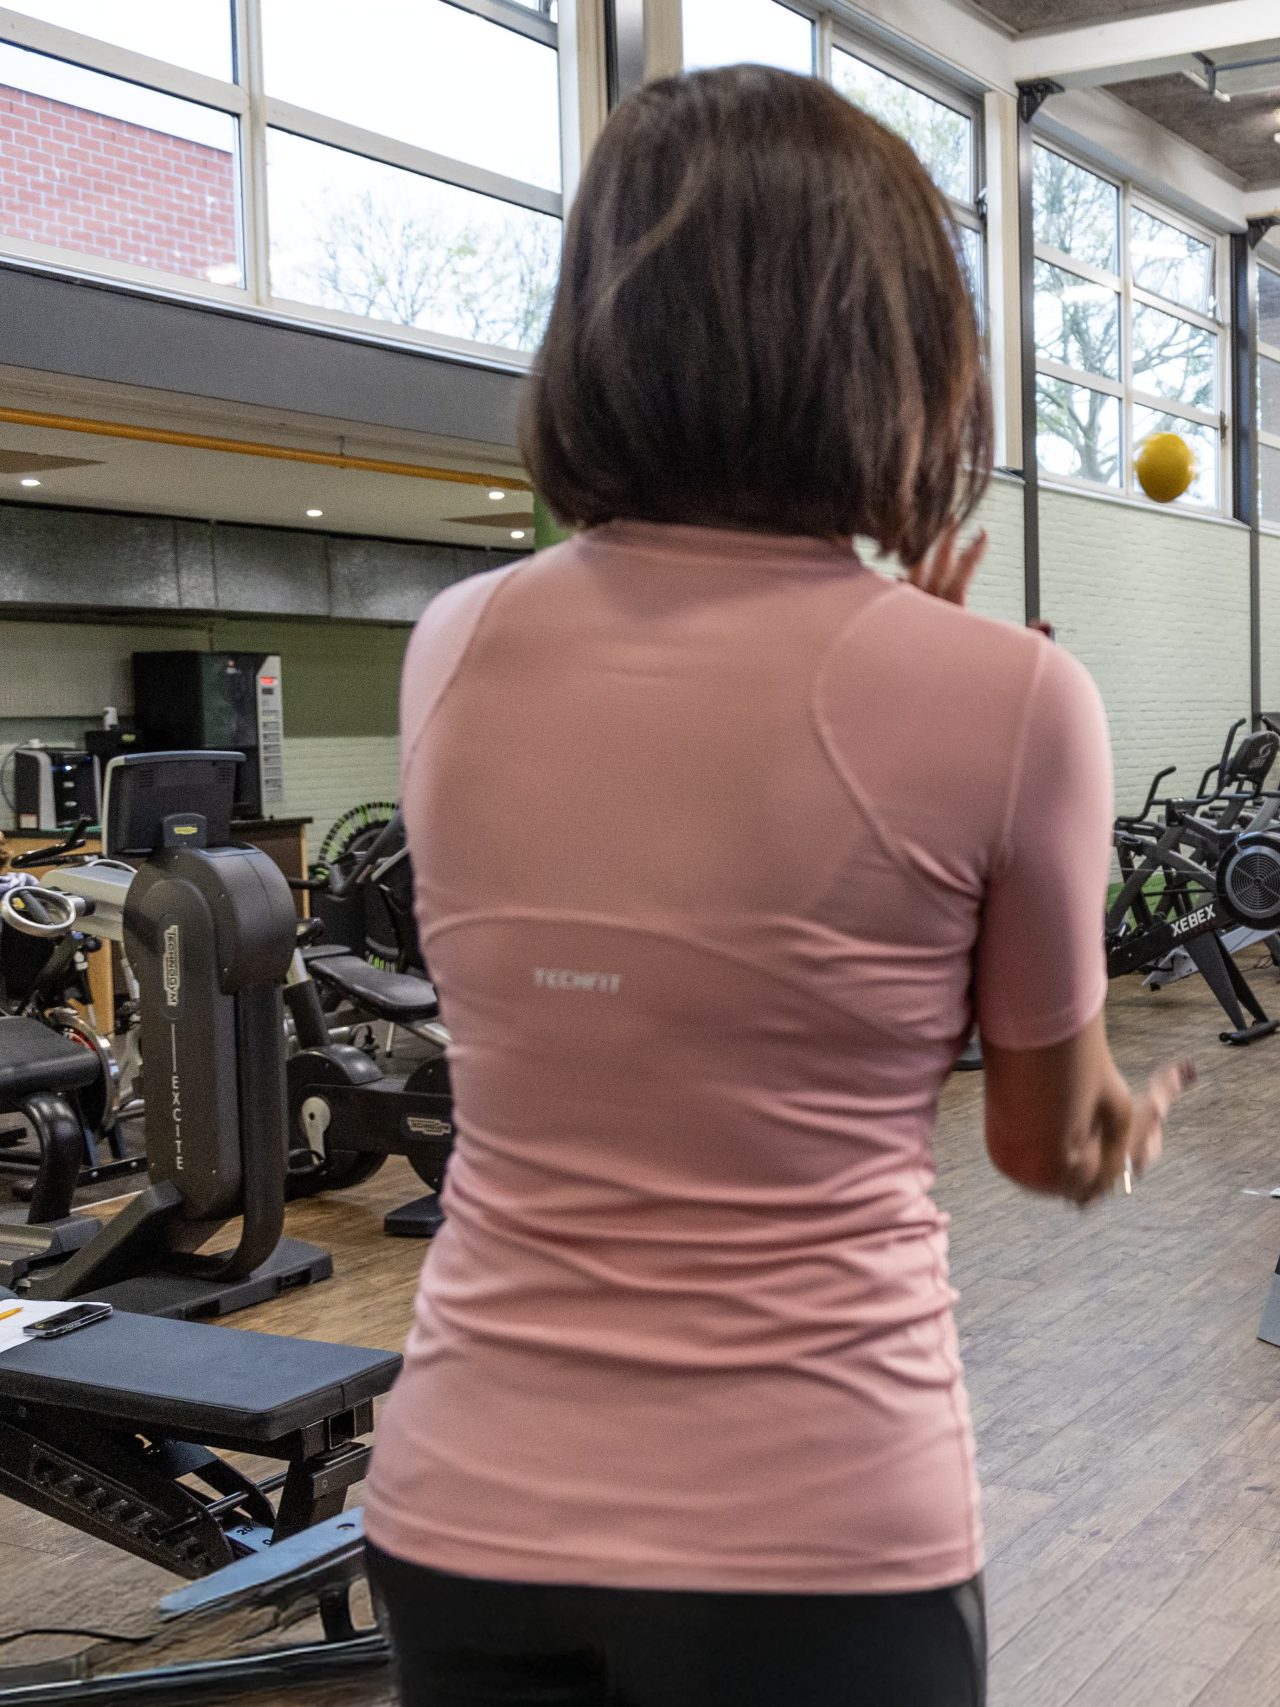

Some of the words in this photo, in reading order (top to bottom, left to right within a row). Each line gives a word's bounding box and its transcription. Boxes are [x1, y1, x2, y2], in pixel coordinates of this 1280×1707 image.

[1170, 903, 1217, 937] XEBEX
[171, 1075, 184, 1170] EXCITE
[236, 1526, 254, 1536] 20
